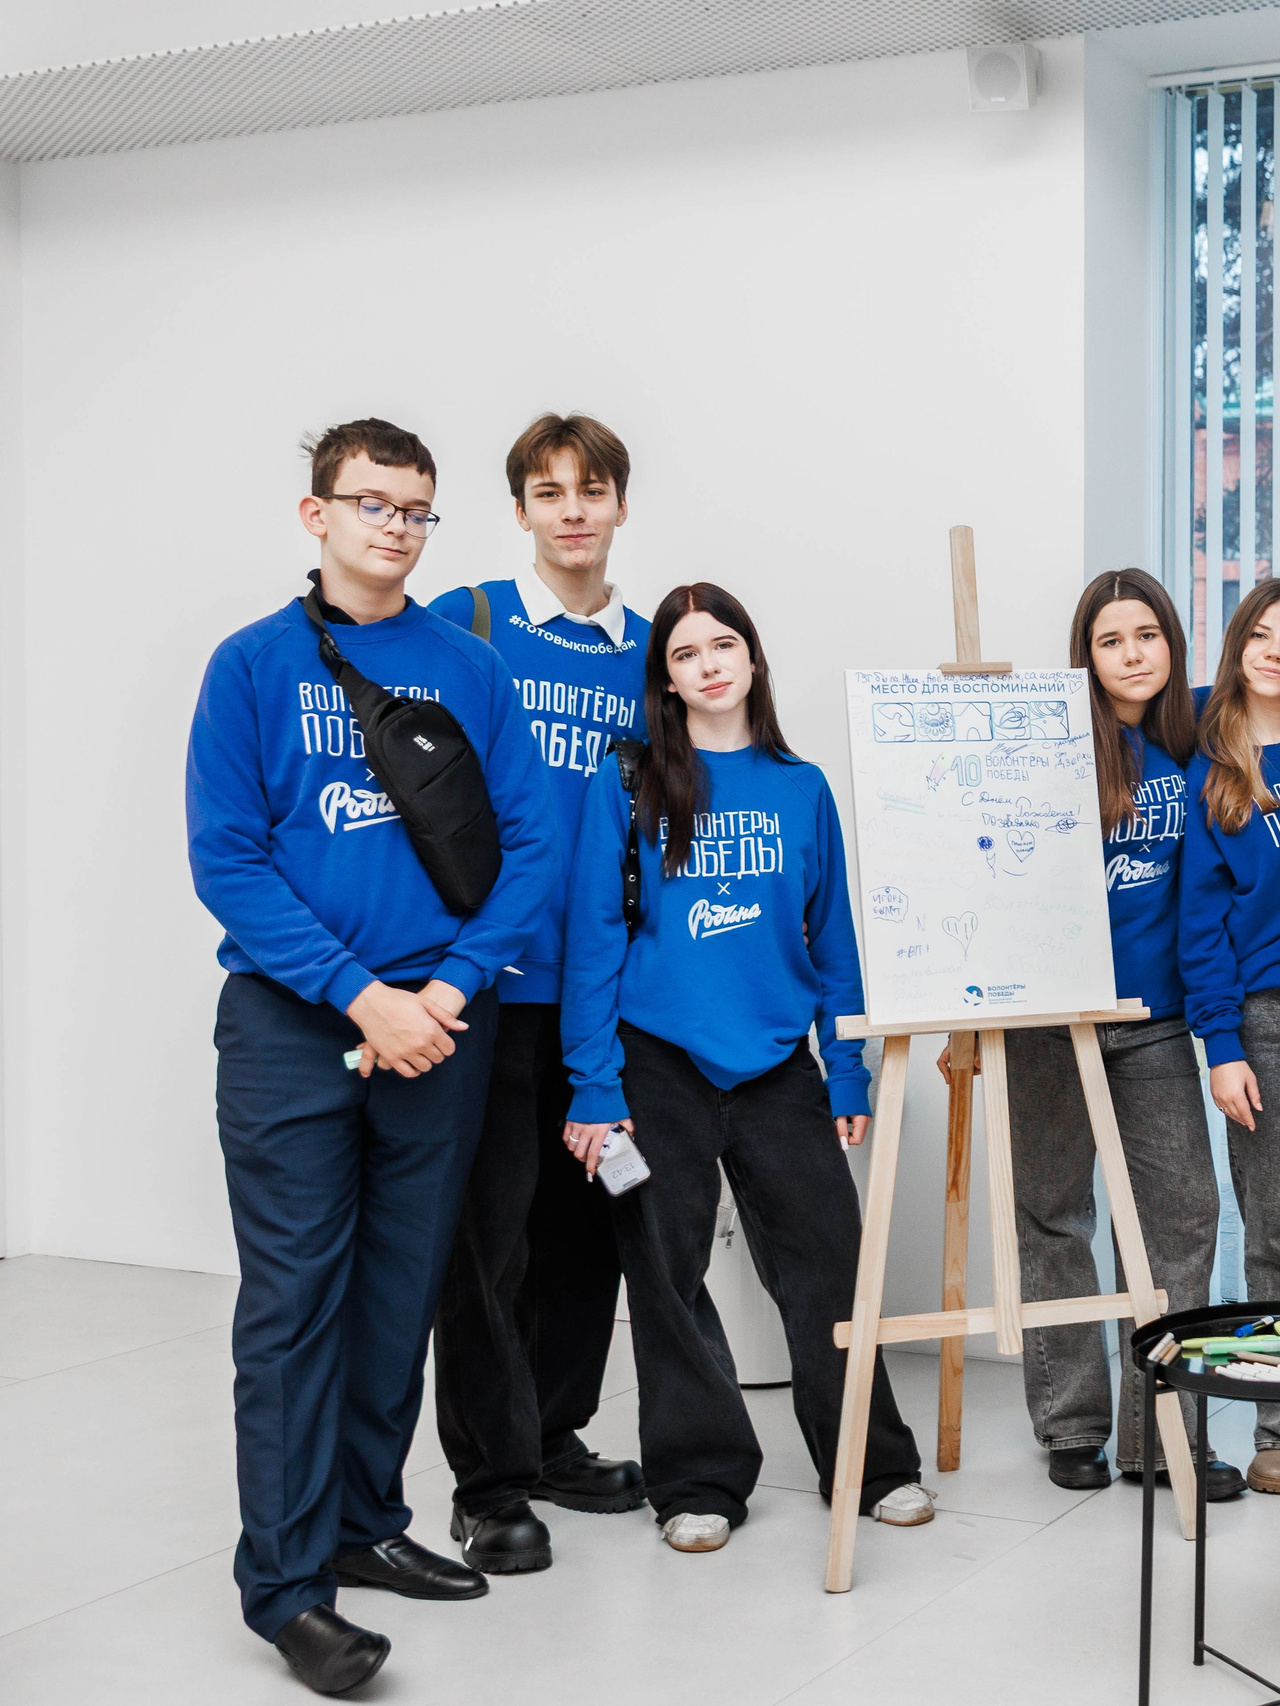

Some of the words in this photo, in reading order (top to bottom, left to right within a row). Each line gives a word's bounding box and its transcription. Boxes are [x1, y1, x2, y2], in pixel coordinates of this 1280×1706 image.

[871, 683, 918, 694] МЕСТО
[921, 683, 949, 696] ДЛЯ
[953, 680, 1066, 694] ВОСПОМИНАНИЙ
[301, 713, 367, 759] ПОБ
[530, 719, 627, 778] ОБЕД
[949, 754, 983, 788] 10
[986, 769, 1030, 782] ПОБЕДЫ
[960, 791, 975, 807] С
[661, 837, 784, 880] ОБЕДЫ
[688, 898, 763, 941] Родина
[987, 984, 1027, 992] ВОЛОНТЁРЫ
[987, 990, 1015, 998] ПОБЕДЫ
[611, 1162, 636, 1179] 13:42
